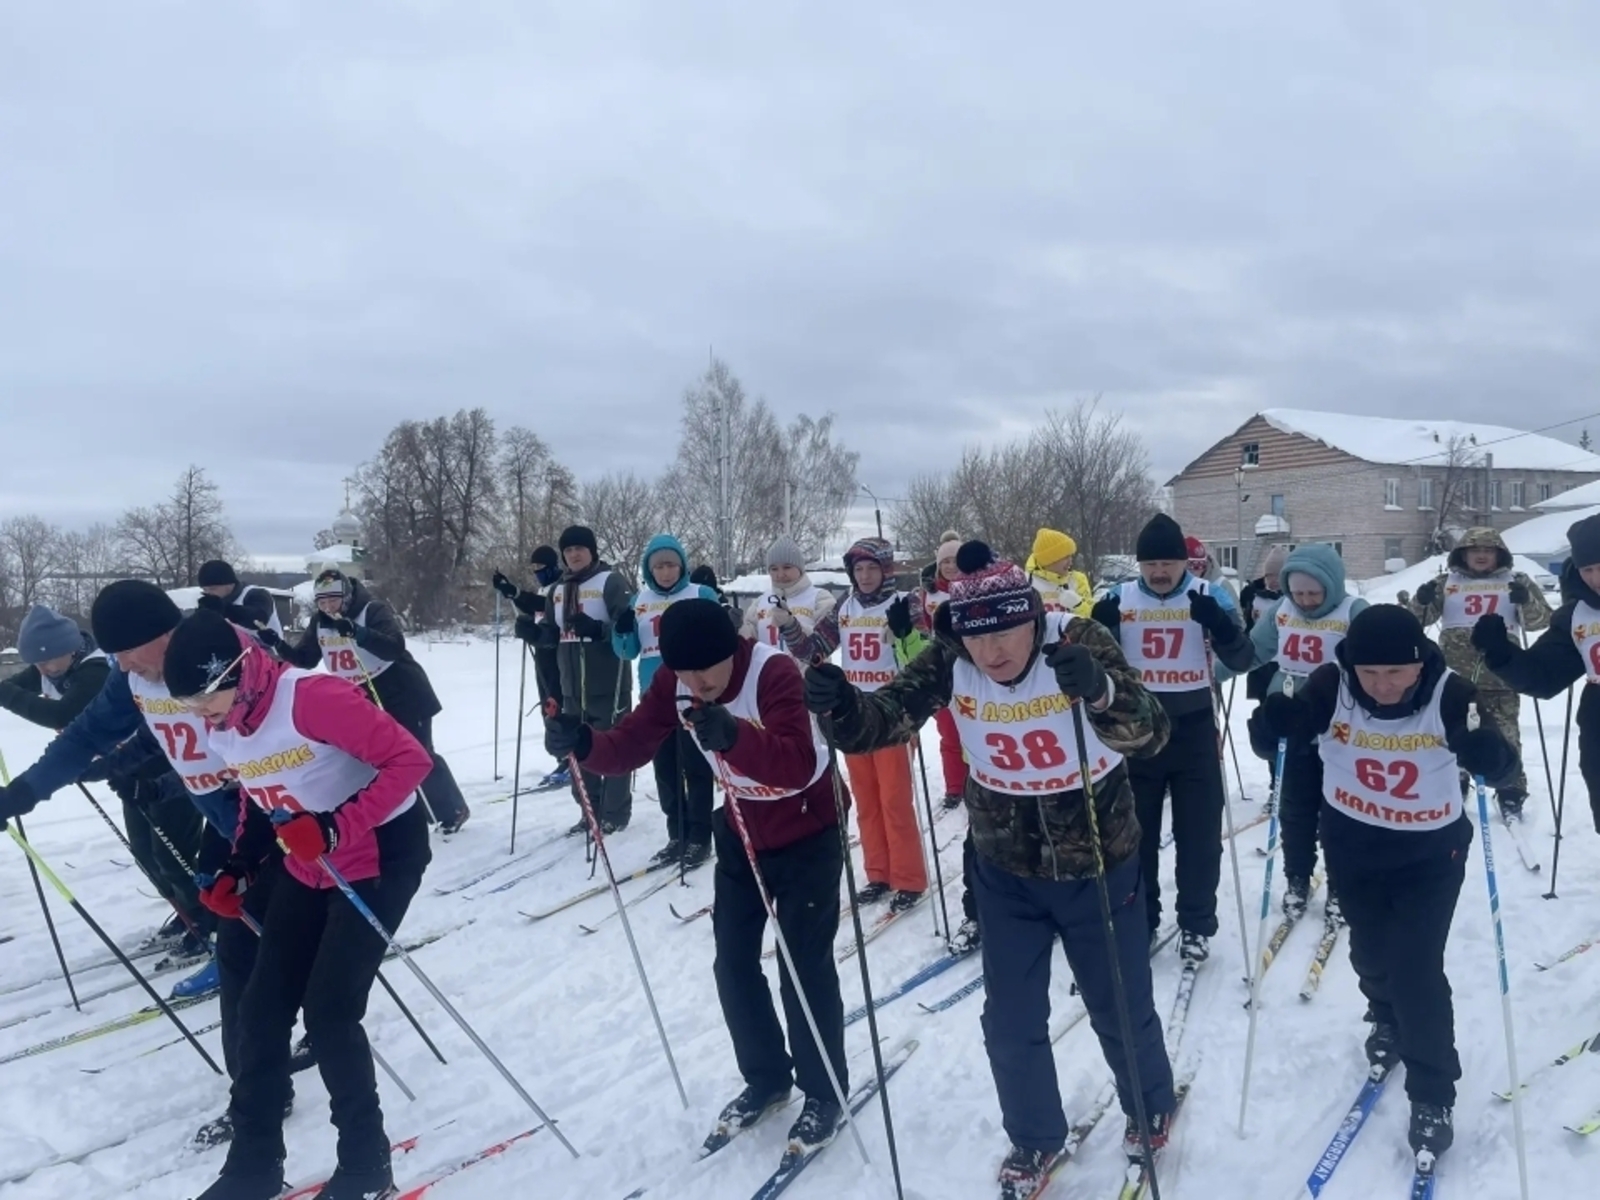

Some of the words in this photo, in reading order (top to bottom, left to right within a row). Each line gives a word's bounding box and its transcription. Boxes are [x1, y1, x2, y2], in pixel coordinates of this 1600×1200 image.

[1464, 594, 1499, 615] 37
[964, 616, 998, 629] SOCHI
[848, 633, 881, 662] 55
[1141, 628, 1184, 660] 57
[1283, 633, 1323, 664] 43
[328, 649, 357, 672] 78
[845, 669, 896, 683] ЛТАСЫ
[1141, 670, 1204, 684] ЛТАСЫ
[980, 693, 1072, 723] ДОВЕРИ
[154, 721, 207, 762] 72
[985, 729, 1067, 771] 38
[238, 743, 316, 779] ОВЕРИЕ
[1355, 758, 1420, 800] 62
[1334, 787, 1451, 824] КАЛТАСЫ
[1313, 1133, 1351, 1180] NORDWAY
